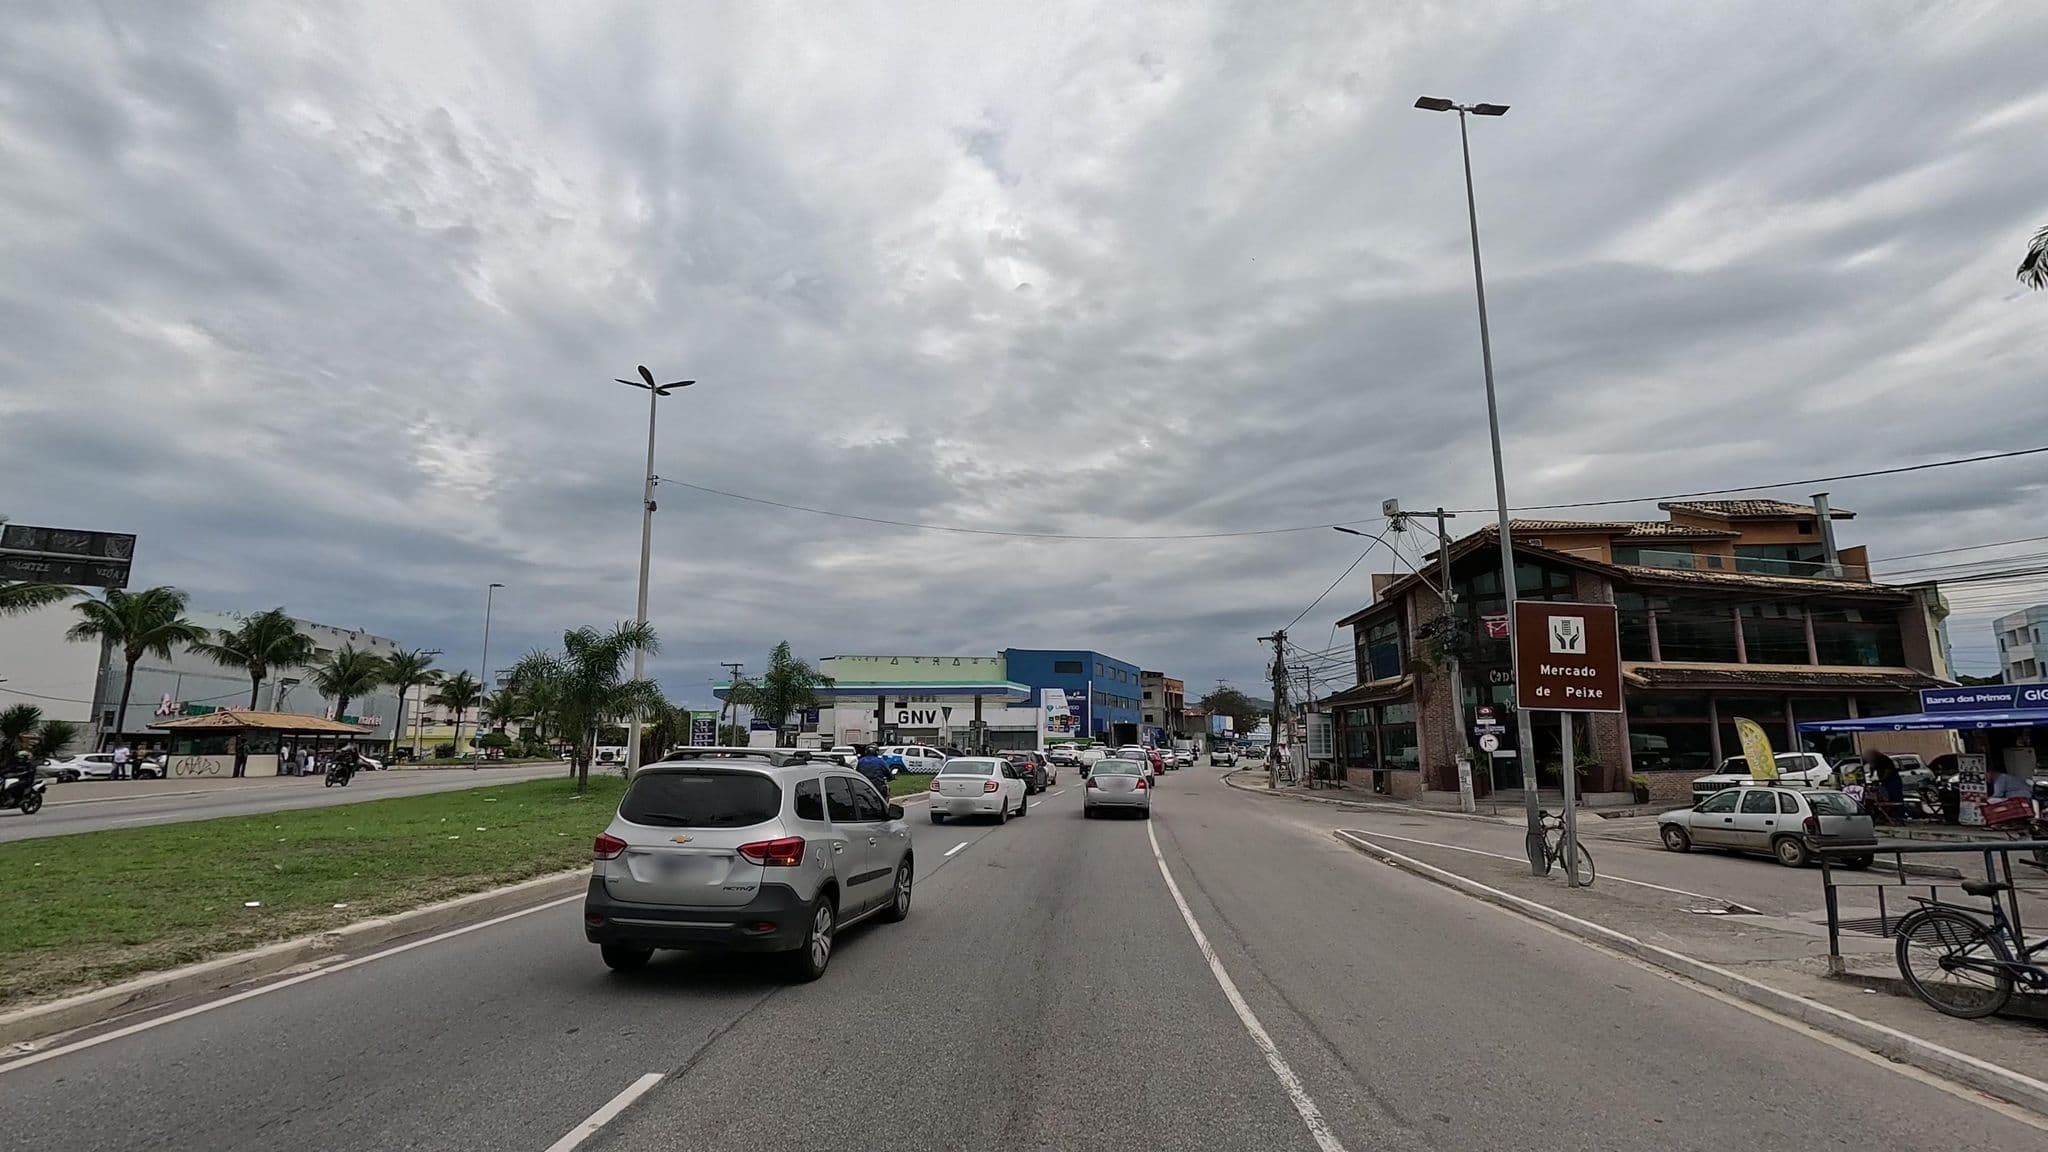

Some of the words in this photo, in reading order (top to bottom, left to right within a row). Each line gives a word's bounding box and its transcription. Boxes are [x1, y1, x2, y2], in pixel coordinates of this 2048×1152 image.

[1540, 664, 1596, 676] Mercado
[1535, 686, 1551, 696] de
[1566, 687, 1603, 698] Peixe
[1956, 695, 1975, 703] dos
[1976, 693, 2012, 702] Primos
[898, 710, 937, 724] GNV
